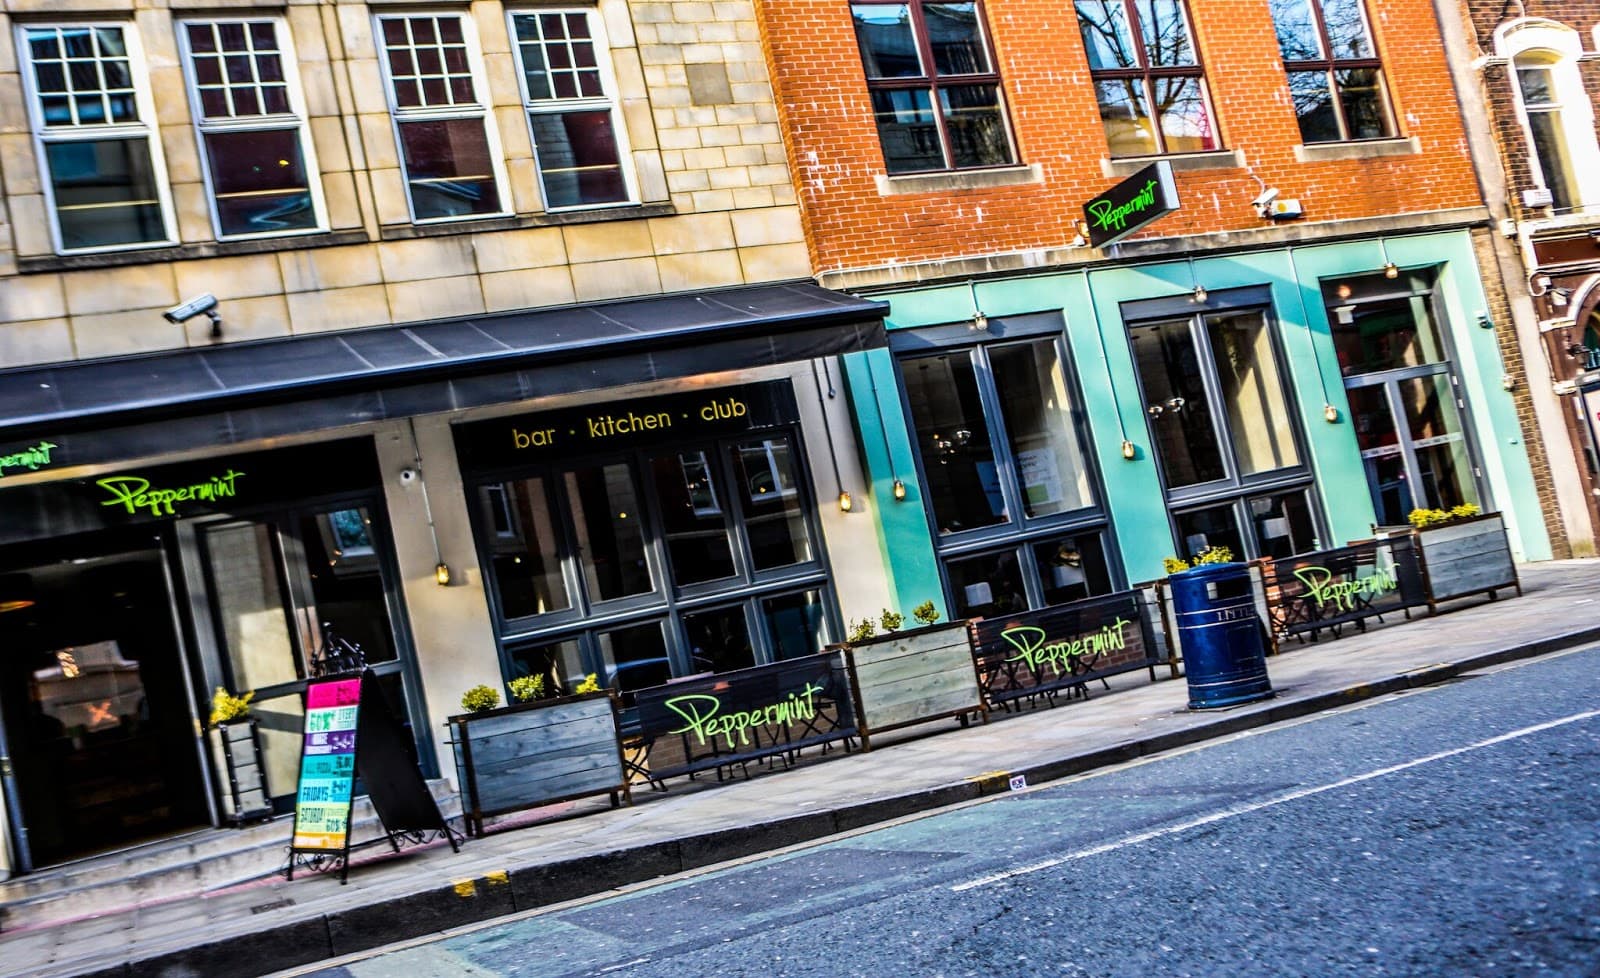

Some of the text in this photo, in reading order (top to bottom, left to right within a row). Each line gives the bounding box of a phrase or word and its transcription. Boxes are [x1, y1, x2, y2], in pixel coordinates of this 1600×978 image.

[1088, 179, 1158, 231] Peppermint
[512, 397, 747, 450] bar kitchen club
[95, 468, 245, 517] Peppermint
[1293, 562, 1401, 611] Peppermint
[1001, 616, 1131, 675] Peppermint
[664, 682, 824, 749] Peppermint
